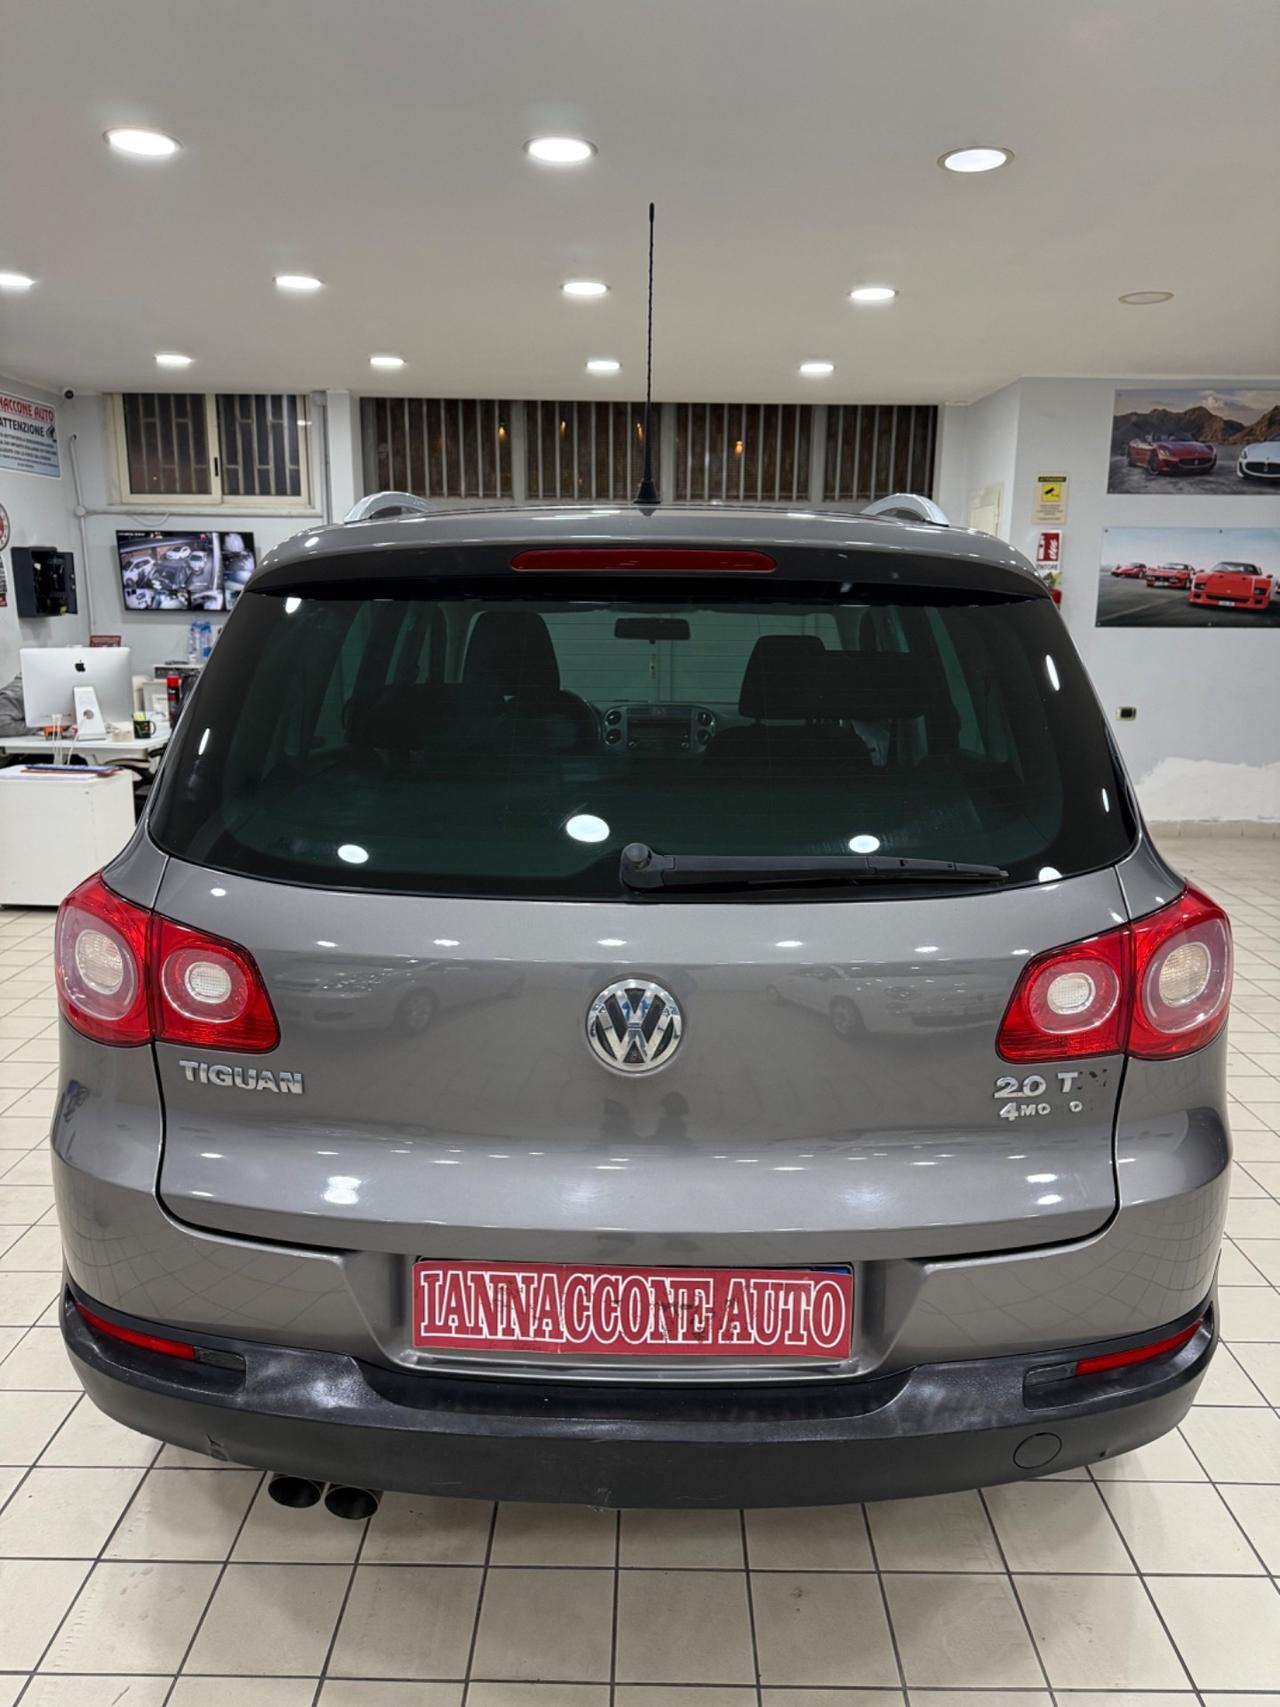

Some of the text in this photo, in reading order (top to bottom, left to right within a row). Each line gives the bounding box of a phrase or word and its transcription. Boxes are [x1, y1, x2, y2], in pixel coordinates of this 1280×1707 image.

[0, 416, 45, 437] ATTENZIONE
[34, 406, 54, 422] AUTO
[587, 979, 681, 1071] VW
[179, 1060, 303, 1094] TIGUAN
[1057, 1071, 1078, 1093] T
[420, 1270, 847, 1348] IANNACCONE AUTO
